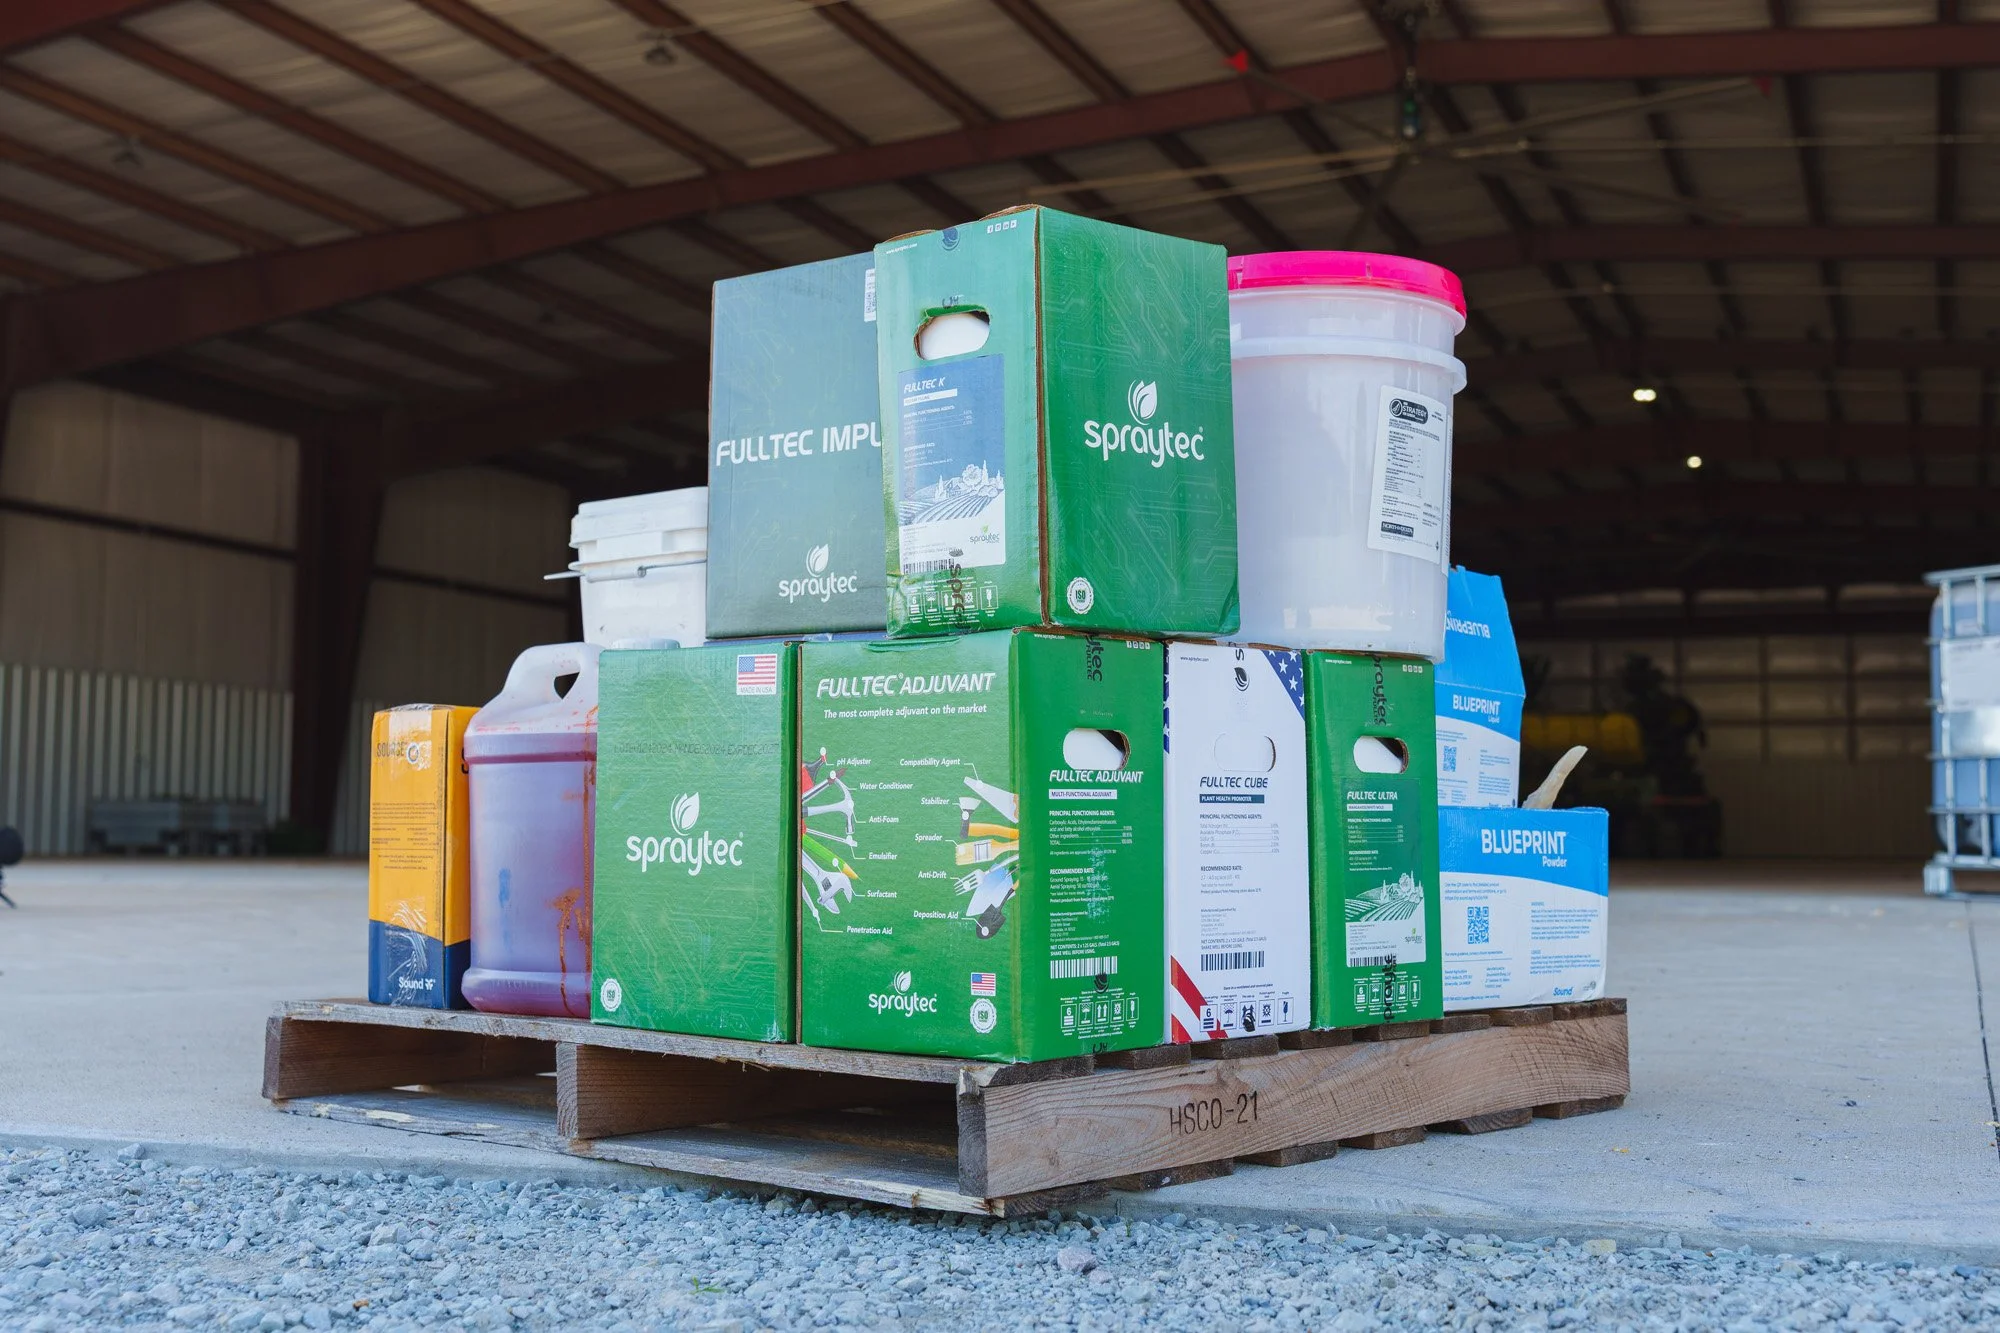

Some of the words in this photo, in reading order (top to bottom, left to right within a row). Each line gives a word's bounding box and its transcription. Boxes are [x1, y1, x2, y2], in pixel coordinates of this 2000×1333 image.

[904, 378, 937, 394] FULLTEC
[938, 376, 946, 387] K
[715, 430, 814, 467] FULLTEC
[1083, 420, 1205, 468] spraytec
[778, 572, 858, 604] spraytec
[1075, 590, 1086, 600] ISO
[816, 674, 897, 699] FULLTEC
[899, 672, 996, 696] ADJUVANT
[1452, 694, 1501, 716] BLUEPRINT
[824, 709, 837, 719] The
[838, 709, 857, 718] most
[859, 707, 894, 720] complete
[895, 706, 928, 718] adjuvant
[930, 707, 941, 715] on
[942, 705, 956, 714] the
[957, 704, 987, 714] market
[836, 758, 846, 766] pH
[846, 758, 872, 766] Adjuster
[900, 758, 939, 767] Compatibility
[940, 758, 960, 767] Agent
[1049, 769, 1094, 782] FULLTEC
[1095, 770, 1144, 783] ADJUVANT
[859, 782, 877, 790] Water
[878, 782, 913, 790] Conditioner
[1199, 776, 1241, 788] FULLTEC
[1244, 777, 1269, 788] CUBE
[1347, 791, 1377, 800] FULLTEC
[1377, 791, 1398, 800] ULTRA
[920, 797, 950, 805] Stabilizer
[868, 815, 899, 823] Anti-Foam
[914, 834, 942, 842] Spreader
[1481, 828, 1567, 855] BLUEPRINT
[626, 830, 743, 877] spraytec
[868, 852, 898, 860] Emulsifier
[1542, 855, 1567, 868] Powder
[918, 871, 947, 879] Anti-Drift
[867, 890, 897, 899] Surfactant
[913, 910, 946, 920] Deposition
[947, 911, 959, 920] Aid
[846, 926, 881, 935] Penetration
[881, 927, 893, 935] Aid
[398, 976, 424, 990] Sound
[1359, 986, 1364, 995] 6
[1553, 986, 1573, 996] Sound
[868, 992, 937, 1018] spraytec
[978, 1010, 988, 1020] ISO
[1066, 1007, 1072, 1016] 6
[1206, 1008, 1212, 1018] 6
